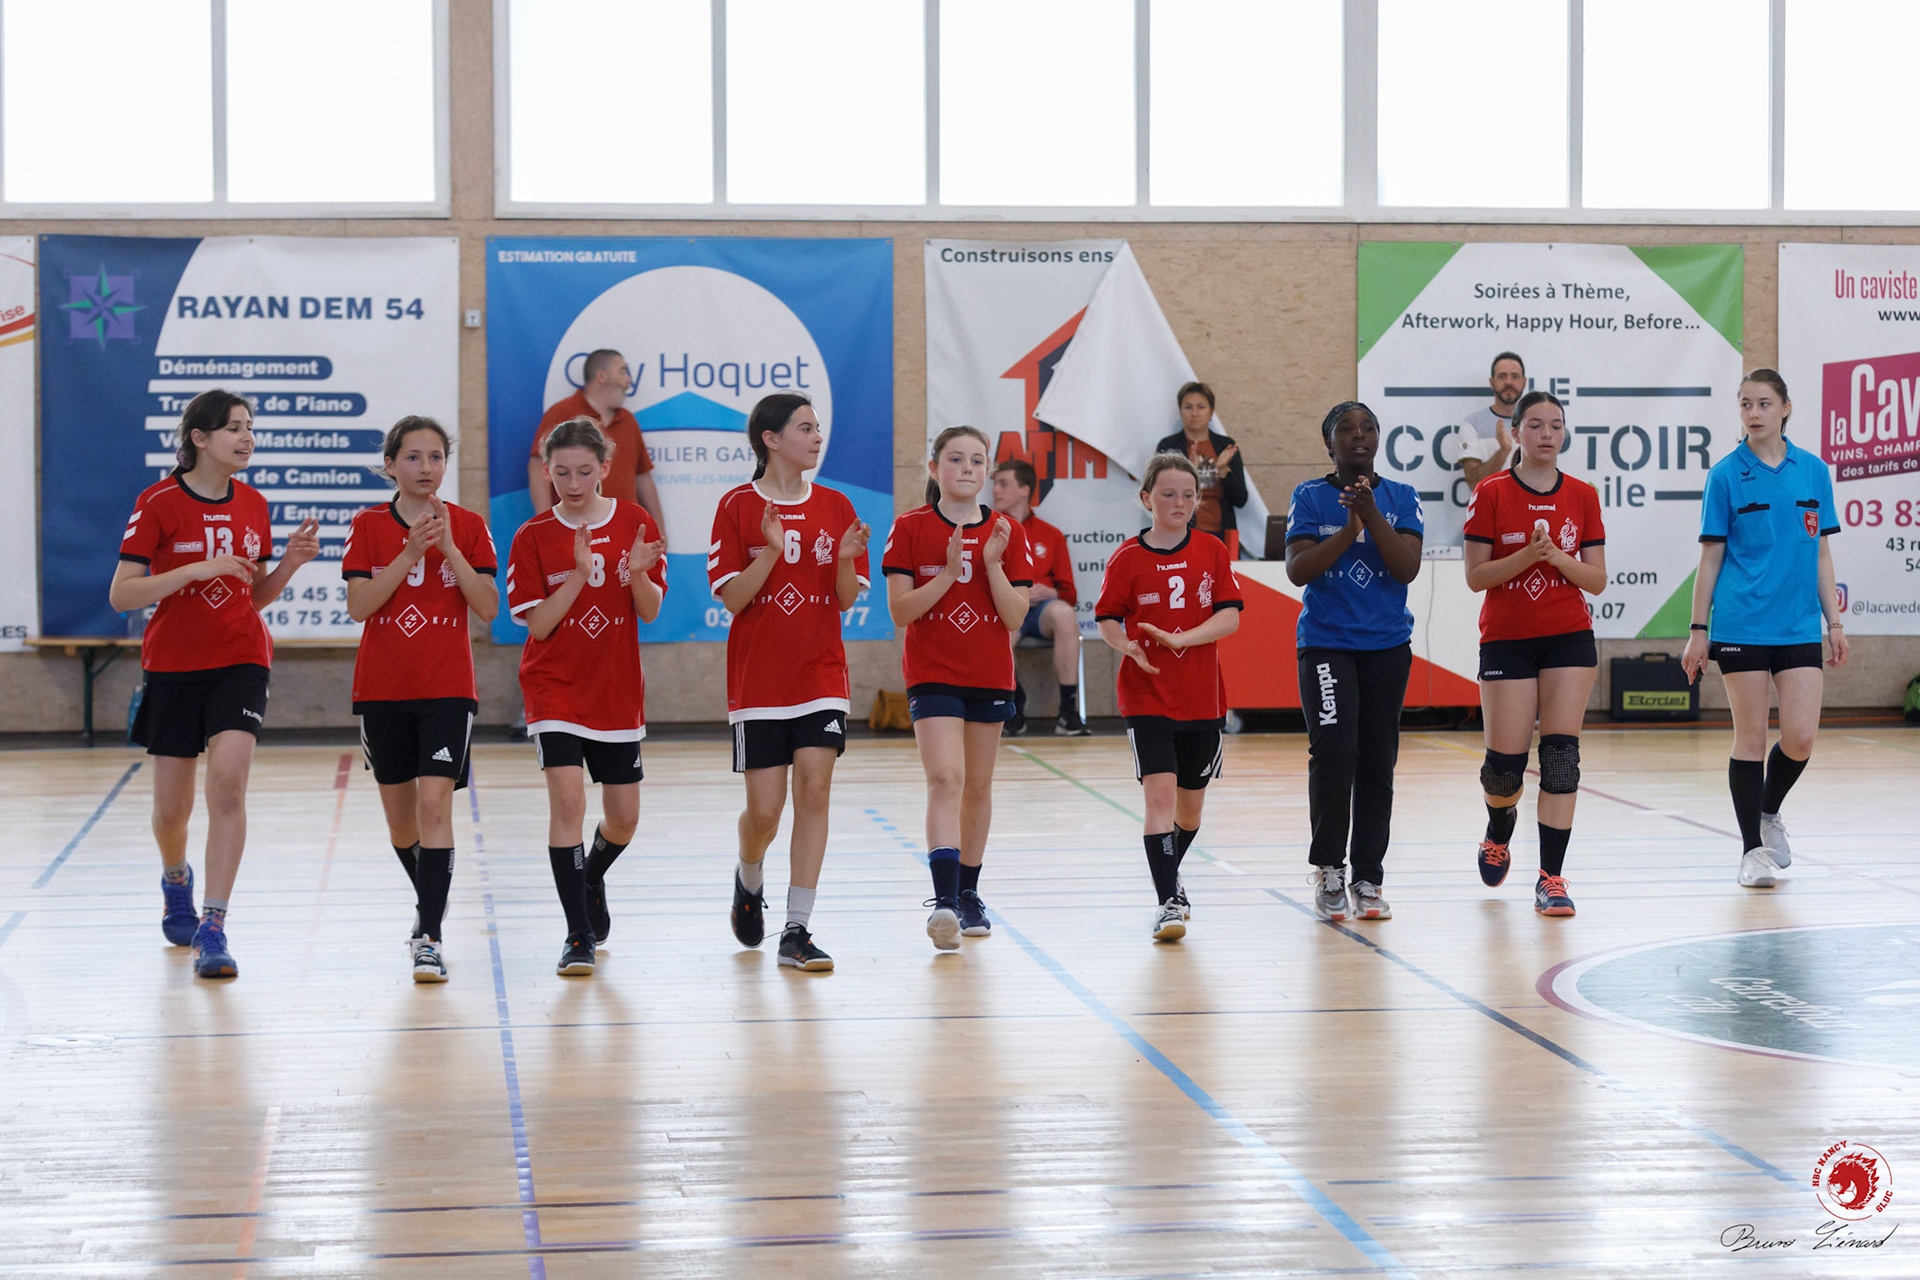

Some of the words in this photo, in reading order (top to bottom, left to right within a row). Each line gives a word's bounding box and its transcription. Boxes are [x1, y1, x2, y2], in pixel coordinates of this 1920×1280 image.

[498, 250, 574, 263] ESTIMATION
[575, 250, 637, 263] GRATUITE
[940, 248, 1073, 263] Construisons
[1474, 283, 1539, 299] Soirées
[1546, 285, 1555, 299] à
[1561, 283, 1630, 302] Thème,
[1835, 269, 1855, 299] Un
[1860, 270, 1917, 300] caviste
[178, 296, 289, 319] RAYAN
[299, 297, 372, 319] DEM
[385, 298, 424, 320] 54
[1401, 313, 1500, 332] Afterwork,
[1506, 314, 1564, 332] Happy
[1569, 314, 1618, 332] Hour,
[1624, 313, 1700, 330] Before...
[158, 359, 319, 379] Déménagement
[659, 353, 810, 397] Hoquet
[264, 397, 291, 412] de
[295, 396, 352, 412] Piano
[1829, 410, 1847, 447] la
[1850, 363, 1920, 444] Cav
[254, 431, 350, 448] Matériels
[1831, 447, 1868, 462] VINS,
[1842, 462, 1864, 478] des
[1868, 457, 1899, 474] tarifs
[1902, 456, 1918, 470] de
[253, 469, 280, 484] de
[284, 469, 362, 485] Camion
[1528, 503, 1556, 511] hummel
[1845, 500, 1884, 527] 03
[203, 513, 232, 522] hummel
[204, 527, 234, 560] 13
[784, 529, 801, 564] 6
[1886, 537, 1905, 551] 43
[587, 553, 606, 588] 8
[1156, 560, 1187, 572] hummel
[1607, 572, 1657, 585] .com
[302, 587, 328, 601] 45
[1168, 575, 1186, 609] 2
[297, 611, 322, 625] 75
[331, 611, 355, 625] 22
[0, 625, 28, 639] ES
[1316, 662, 1338, 726] Kempa
[1627, 694, 1687, 706] Bodet
